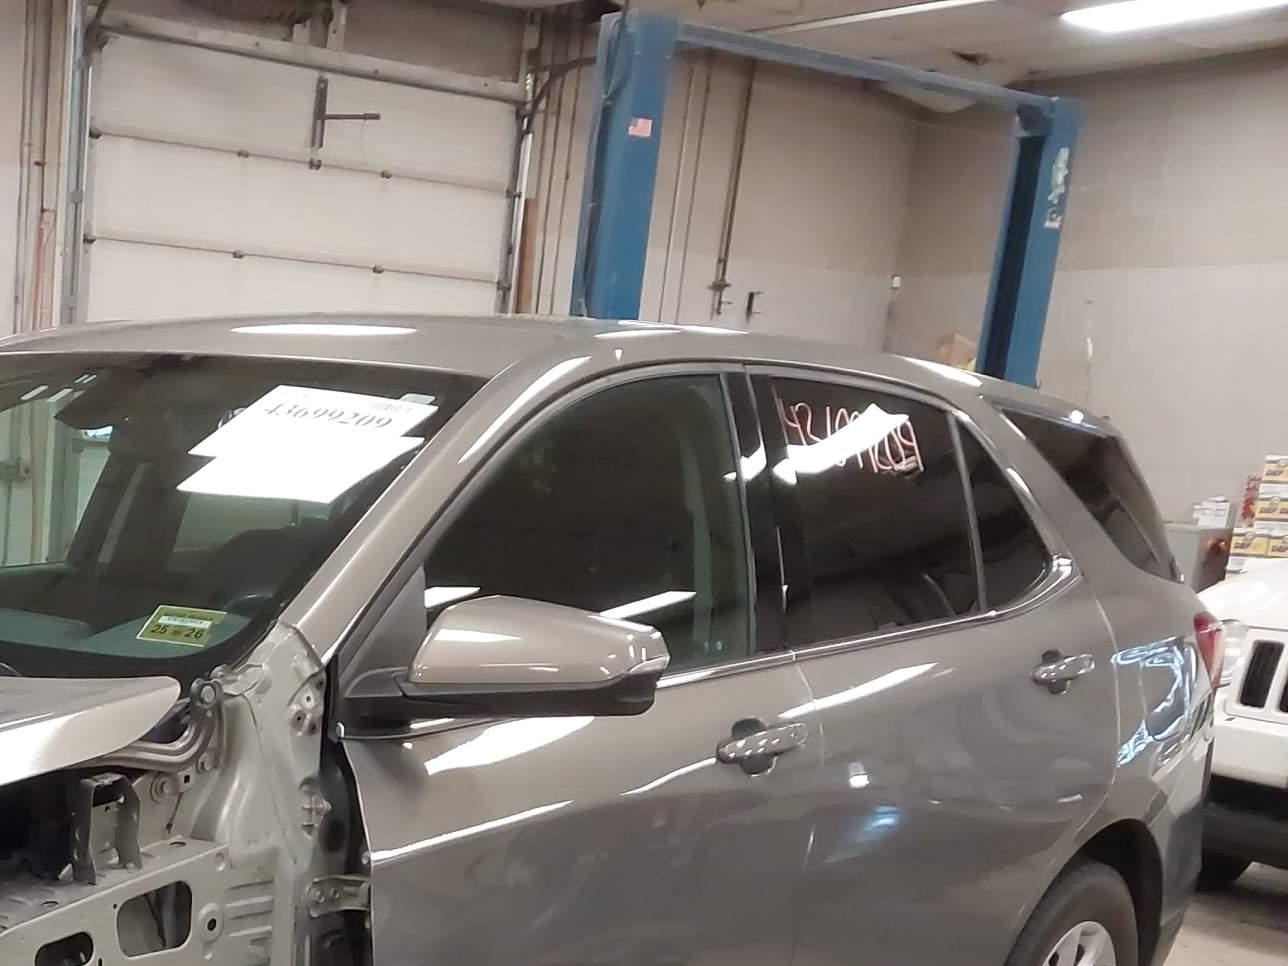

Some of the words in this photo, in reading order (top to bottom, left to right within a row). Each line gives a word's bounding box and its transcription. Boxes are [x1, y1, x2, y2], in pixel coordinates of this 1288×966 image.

[264, 402, 393, 429] 43699209
[151, 624, 169, 634] 25
[184, 628, 205, 639] 26
